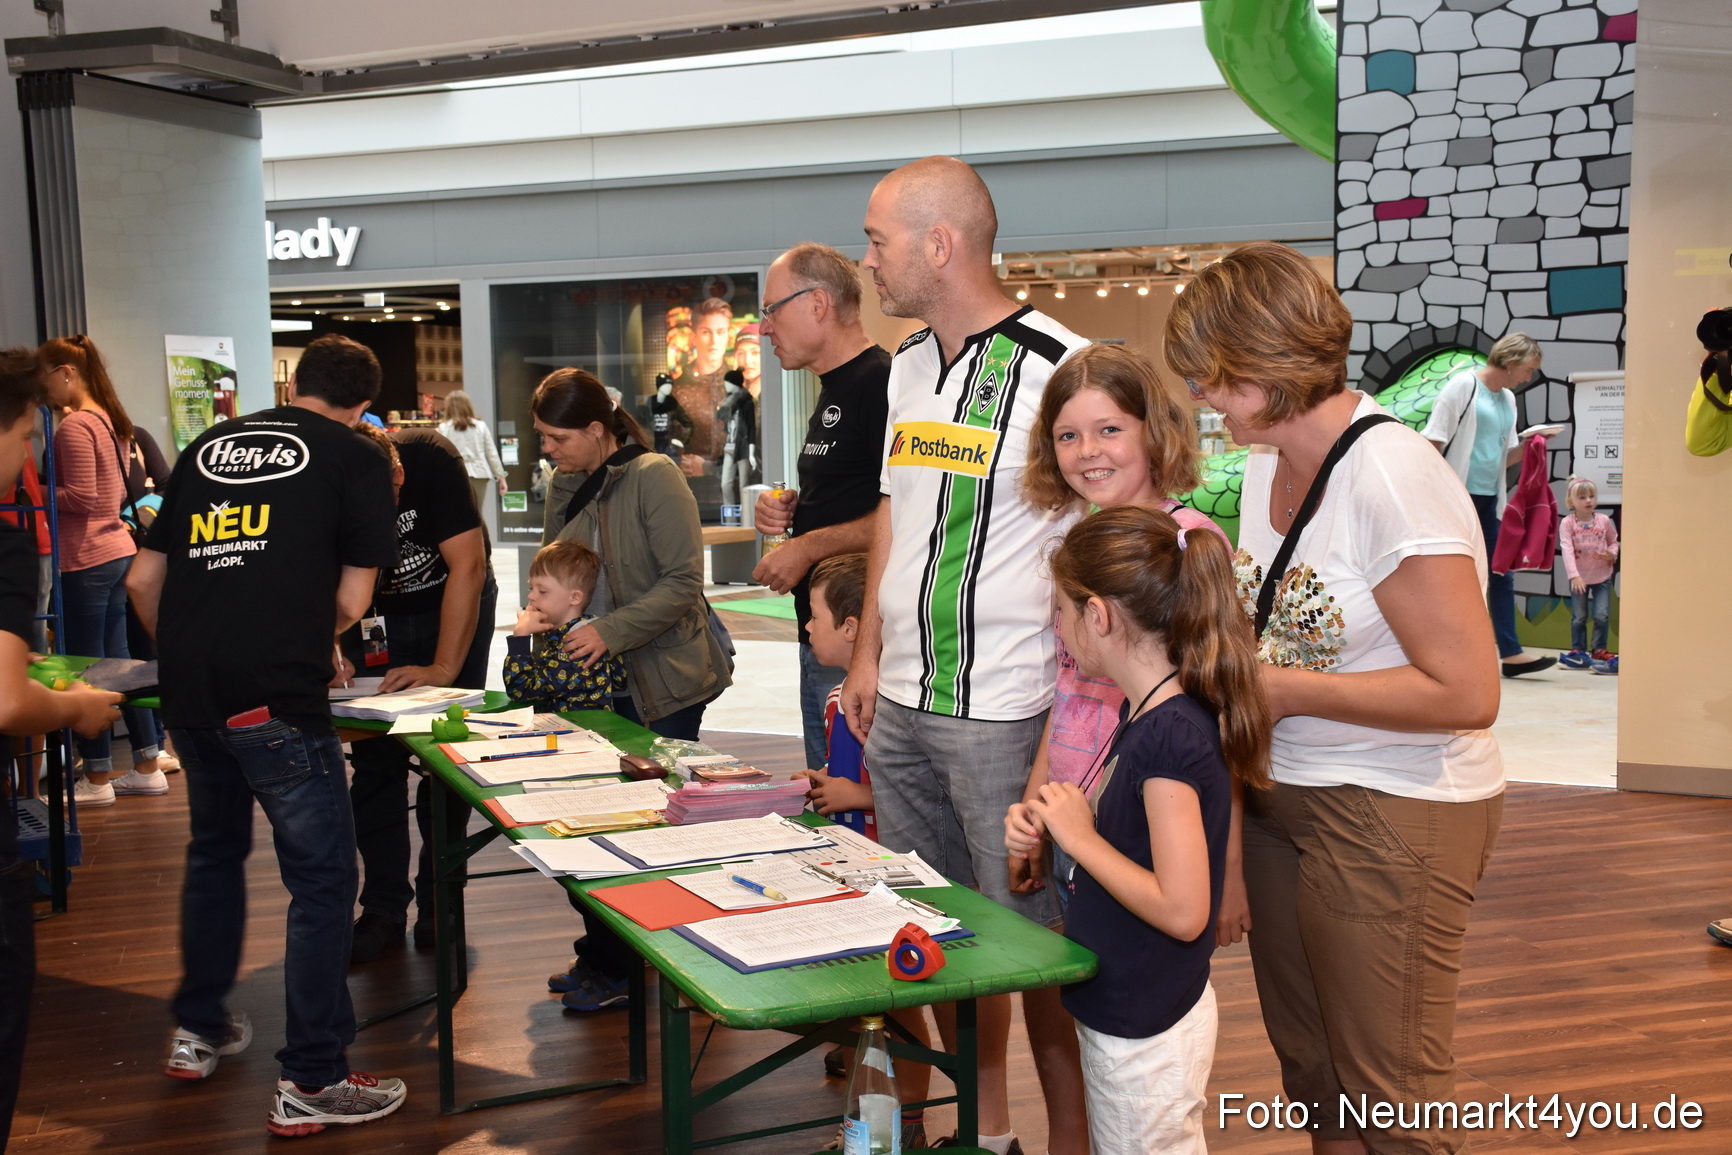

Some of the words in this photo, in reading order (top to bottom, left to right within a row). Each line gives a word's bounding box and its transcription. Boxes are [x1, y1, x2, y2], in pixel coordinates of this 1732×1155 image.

[265, 217, 362, 266] lady
[172, 365, 196, 376] Mein
[174, 378, 208, 388] Genuss-
[175, 389, 210, 399] moment
[208, 440, 298, 470] Hervis
[910, 436, 988, 466] Postbank
[211, 464, 252, 473] SPORTS
[190, 504, 271, 544] NEU
[188, 547, 202, 559] IN
[202, 540, 268, 557] NEUMARKT
